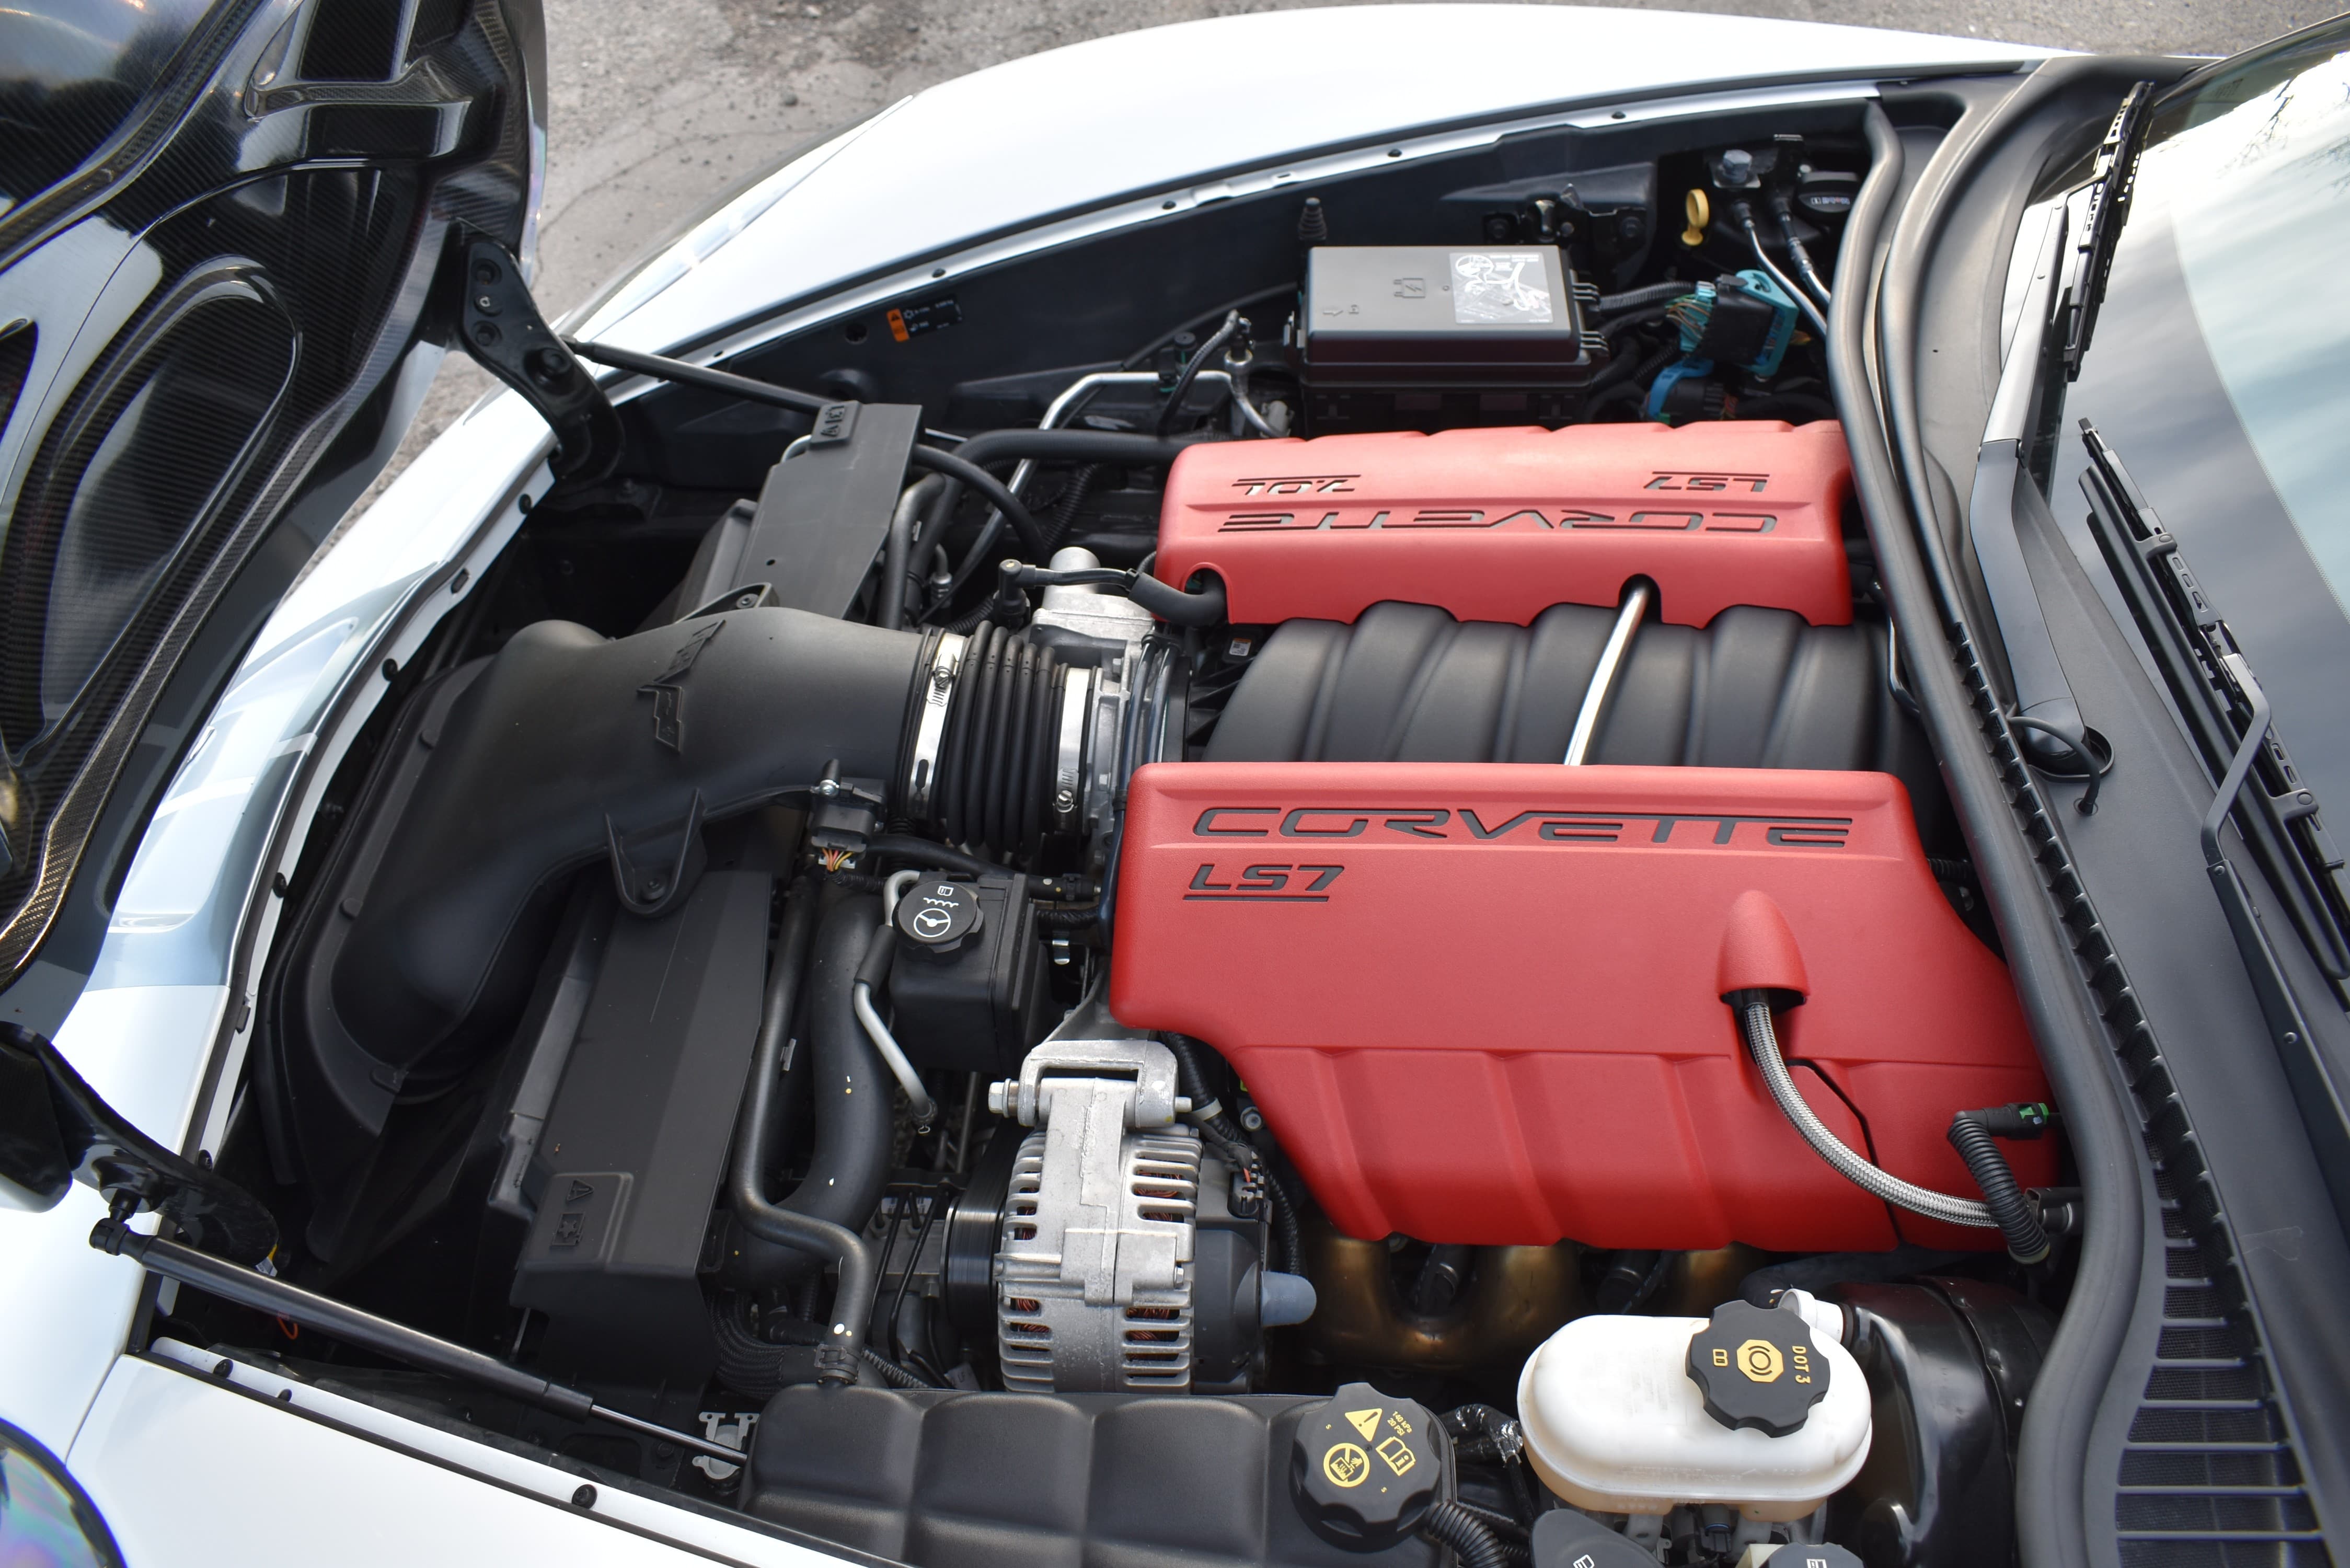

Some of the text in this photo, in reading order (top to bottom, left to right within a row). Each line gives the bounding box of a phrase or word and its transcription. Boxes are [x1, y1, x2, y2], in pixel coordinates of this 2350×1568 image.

[1231, 479, 1355, 495] 7.0L
[1643, 476, 1768, 492] LS7
[1217, 510, 1778, 533] CORVETTE
[1193, 806, 1852, 848] CORVETTE
[1188, 864, 1345, 891] LS7
[1792, 1345, 1811, 1383] DOT 3
[1387, 1417, 1406, 1436] 20 PSI
[1392, 1411, 1412, 1433] 140 kPa
